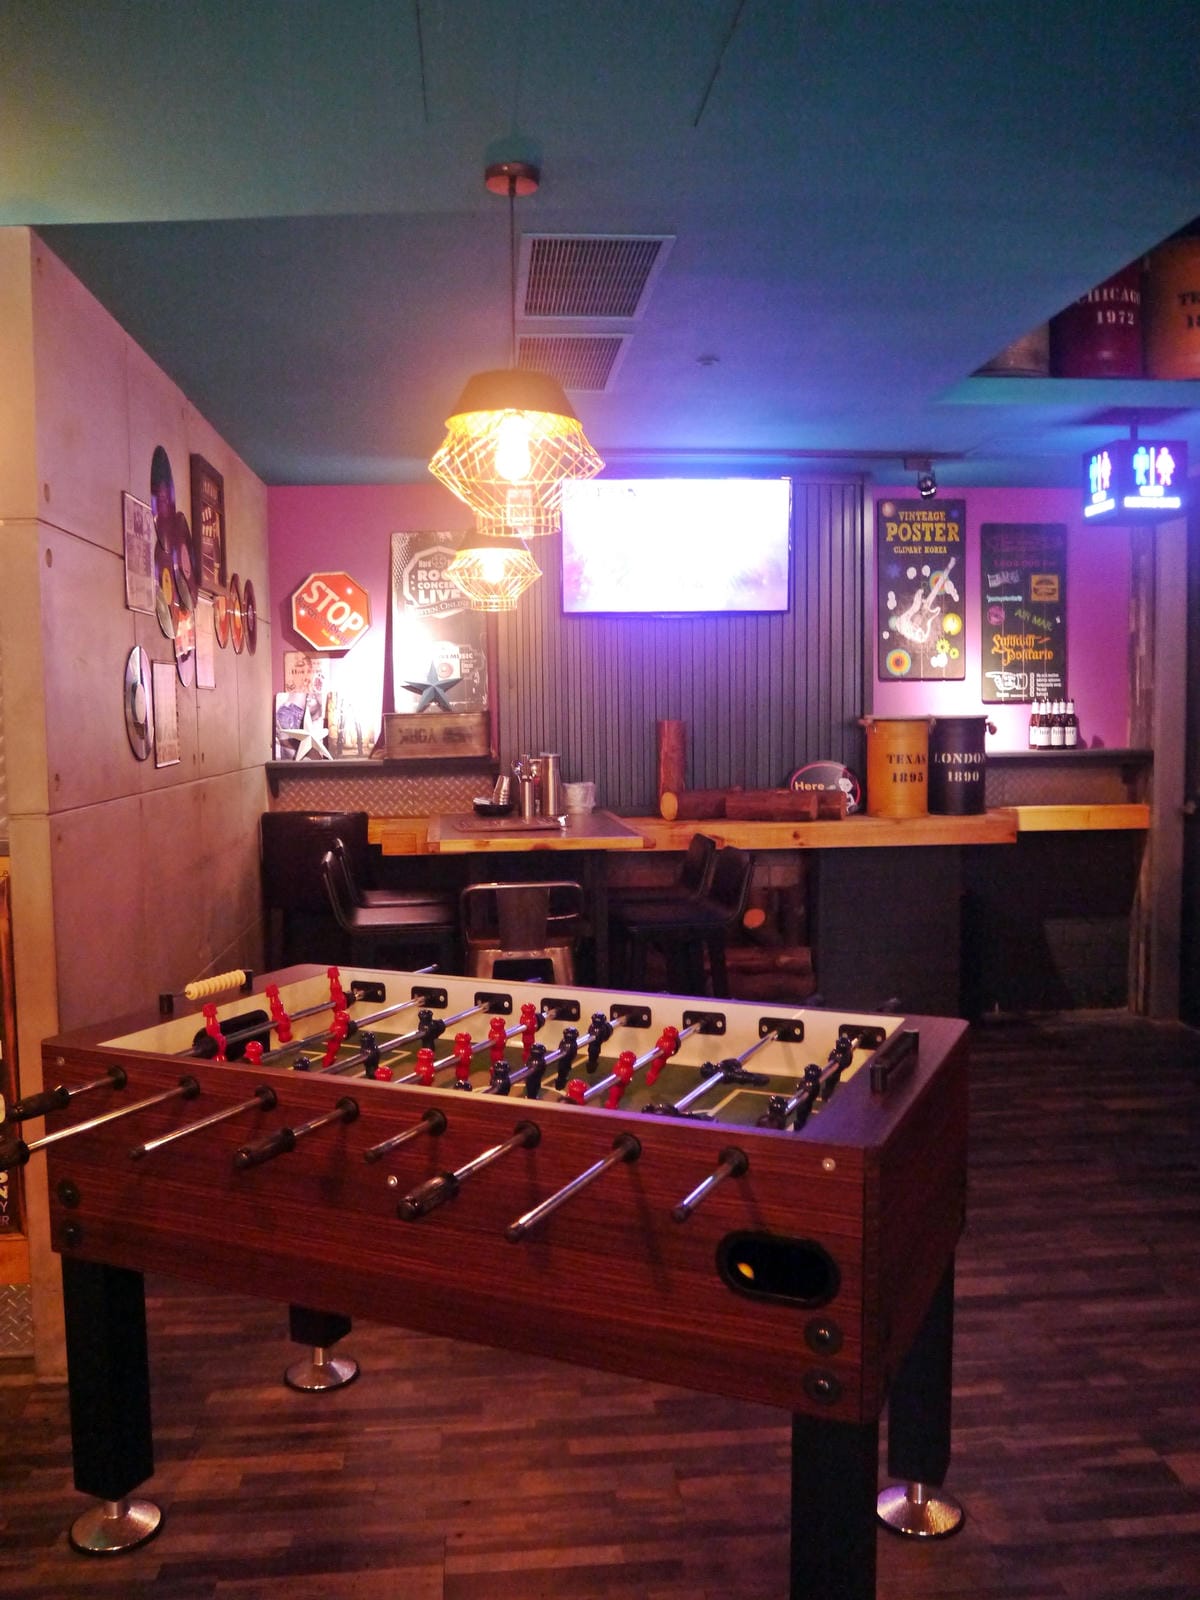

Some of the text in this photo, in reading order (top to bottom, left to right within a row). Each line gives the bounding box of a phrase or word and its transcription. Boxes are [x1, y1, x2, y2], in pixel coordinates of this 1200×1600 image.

[1097, 311, 1134, 325] 1972
[886, 522, 960, 542] POSTER
[924, 546, 947, 554] KOREA
[302, 581, 364, 633] STOP
[886, 753, 927, 764] TEXAS
[948, 771, 979, 782] 1890
[795, 781, 825, 791] Here
